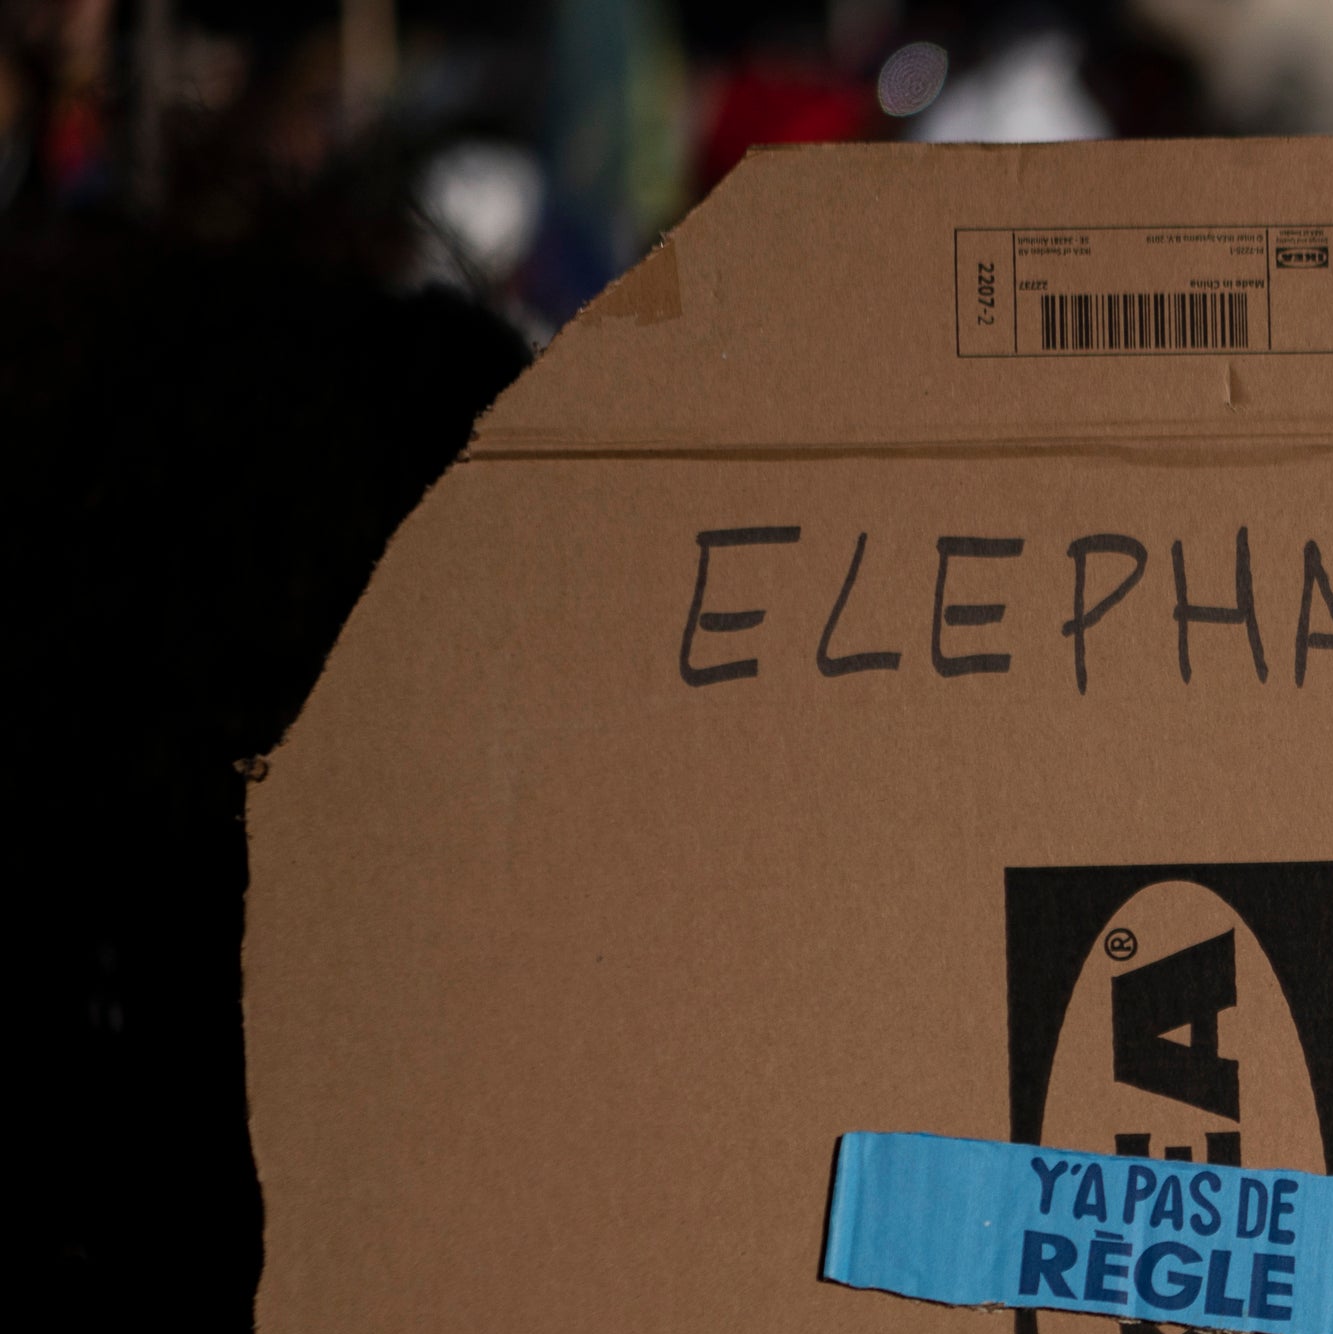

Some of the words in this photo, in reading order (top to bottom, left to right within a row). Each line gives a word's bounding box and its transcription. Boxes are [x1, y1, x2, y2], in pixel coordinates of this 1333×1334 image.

[1190, 279, 1220, 289] China
[1223, 280, 1233, 288] in
[1236, 280, 1265, 289] Made
[977, 262, 995, 326] 2207-2
[1122, 1163, 1223, 1237] PAS
[1235, 1176, 1300, 1246] DE
